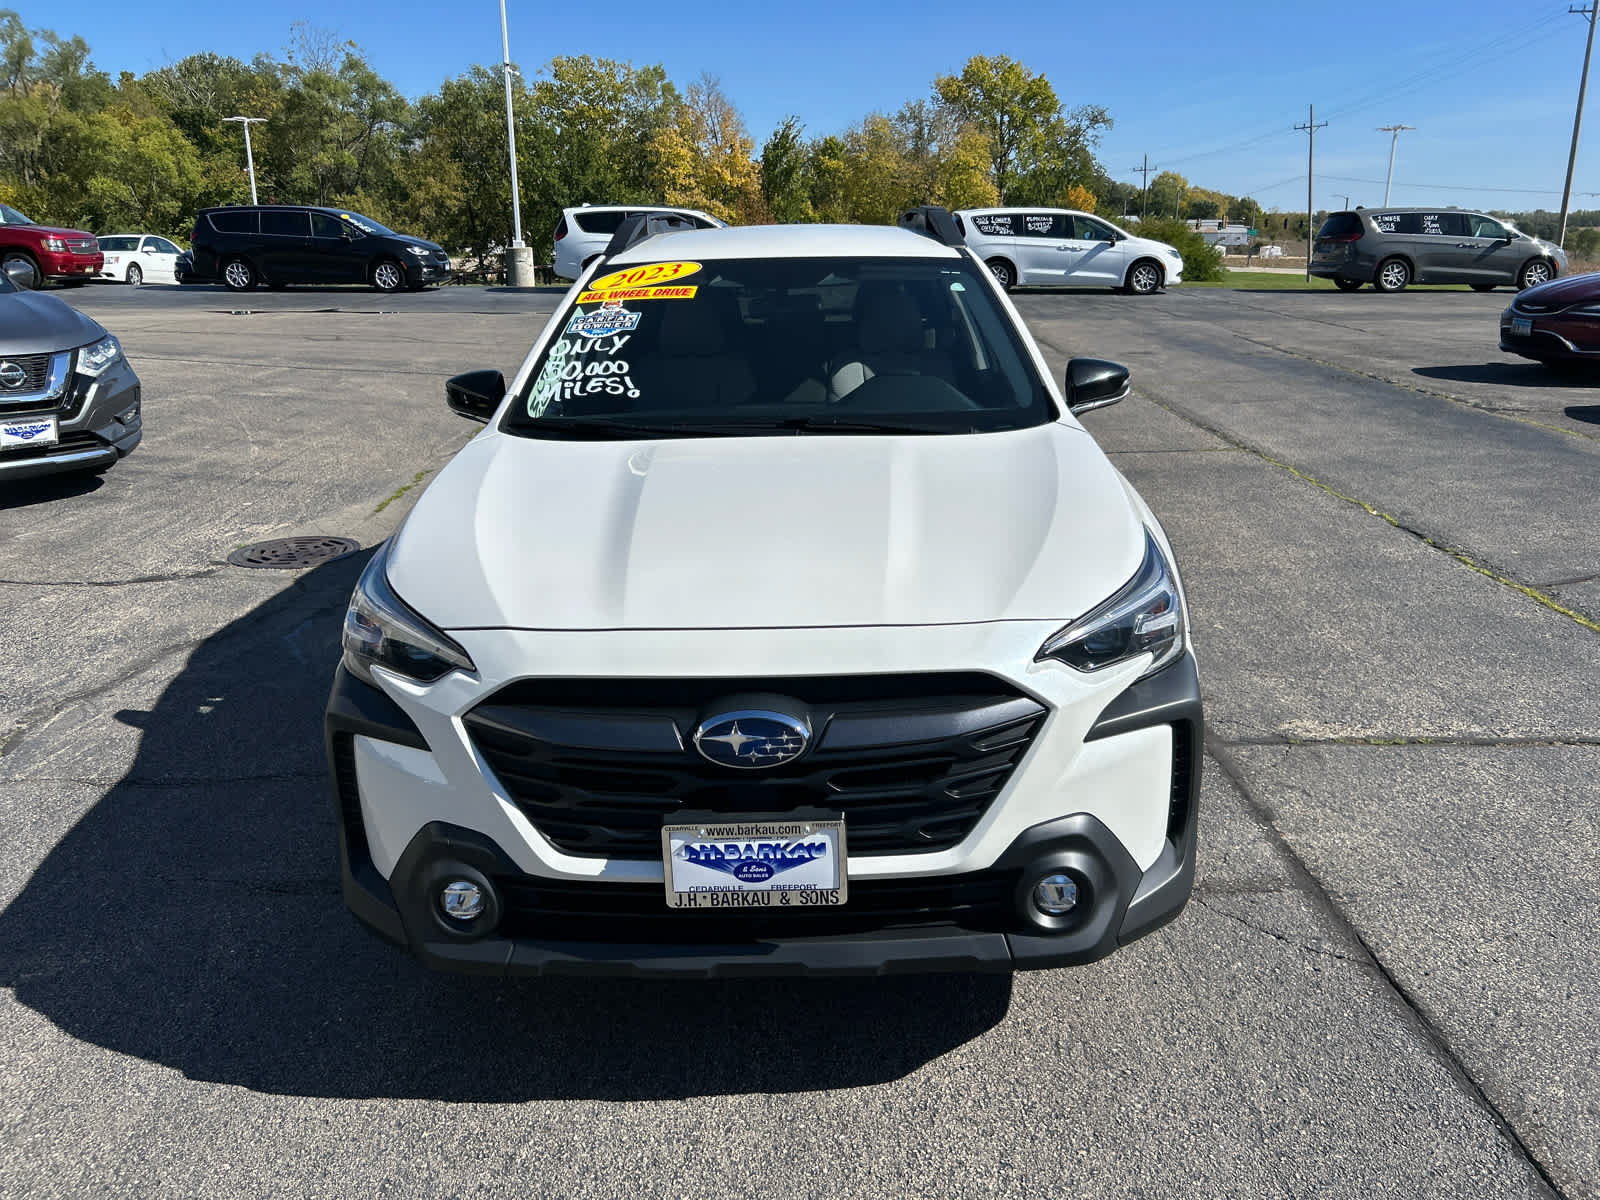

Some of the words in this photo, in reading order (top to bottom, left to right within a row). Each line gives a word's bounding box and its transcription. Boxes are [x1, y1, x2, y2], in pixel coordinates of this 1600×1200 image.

[608, 263, 682, 288] 2023
[581, 292, 605, 302] ALL
[608, 290, 651, 300] WHEEL
[653, 287, 692, 297] DRIVE
[576, 314, 636, 325] CARFAX
[549, 335, 631, 356] ONLY
[705, 824, 801, 837] www.barkau.com
[711, 892, 771, 907] BARKAU
[780, 892, 791, 905] &
[799, 890, 839, 905] SONS
